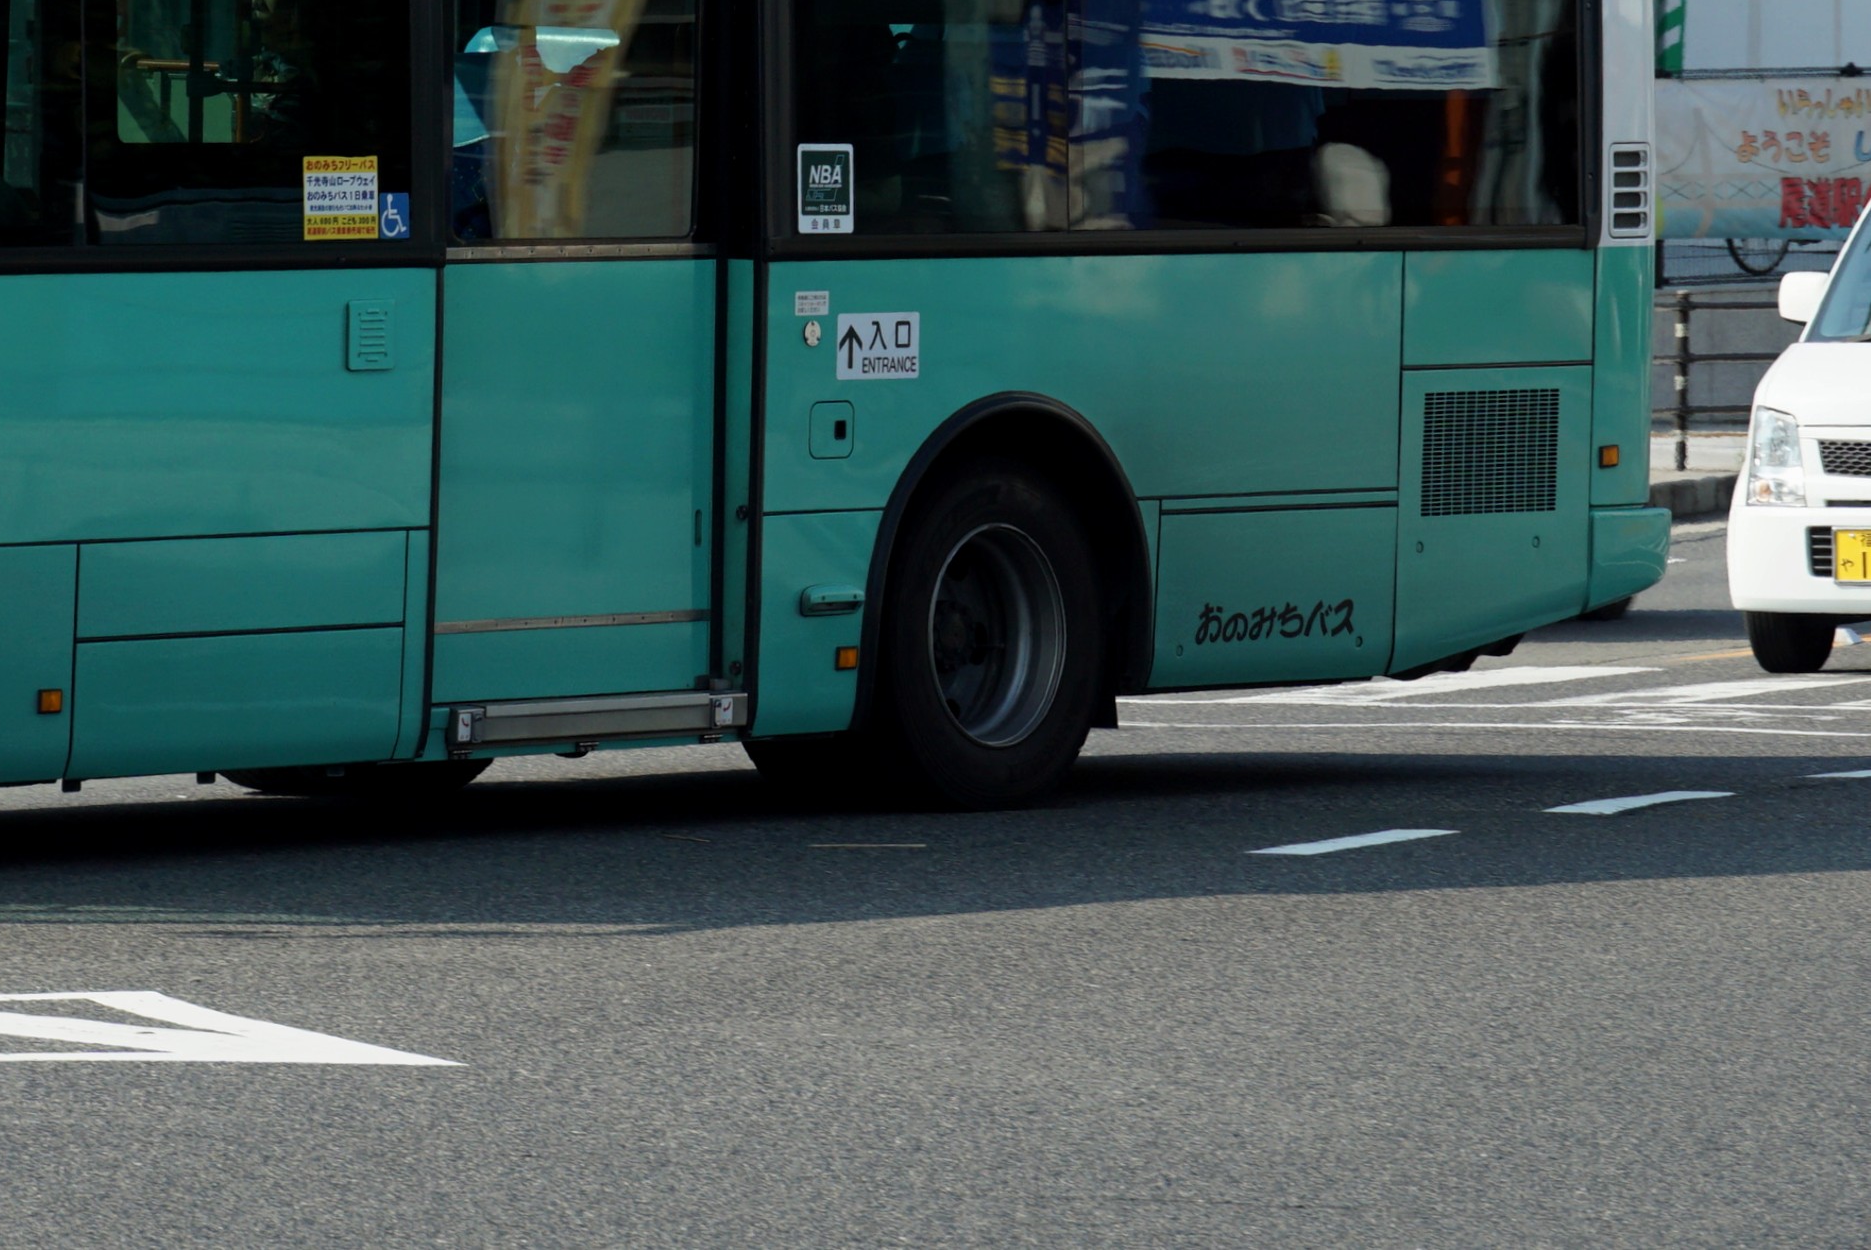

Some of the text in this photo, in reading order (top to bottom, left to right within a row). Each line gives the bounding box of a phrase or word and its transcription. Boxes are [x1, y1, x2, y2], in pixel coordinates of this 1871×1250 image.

[1736, 130, 1832, 164] ようこそ
[809, 165, 842, 184] NBA
[1778, 176, 1871, 229] 尾道駅
[868, 320, 911, 351] 入口
[861, 356, 917, 374] ENTRANCE
[1195, 598, 1355, 645] おのみちバス
